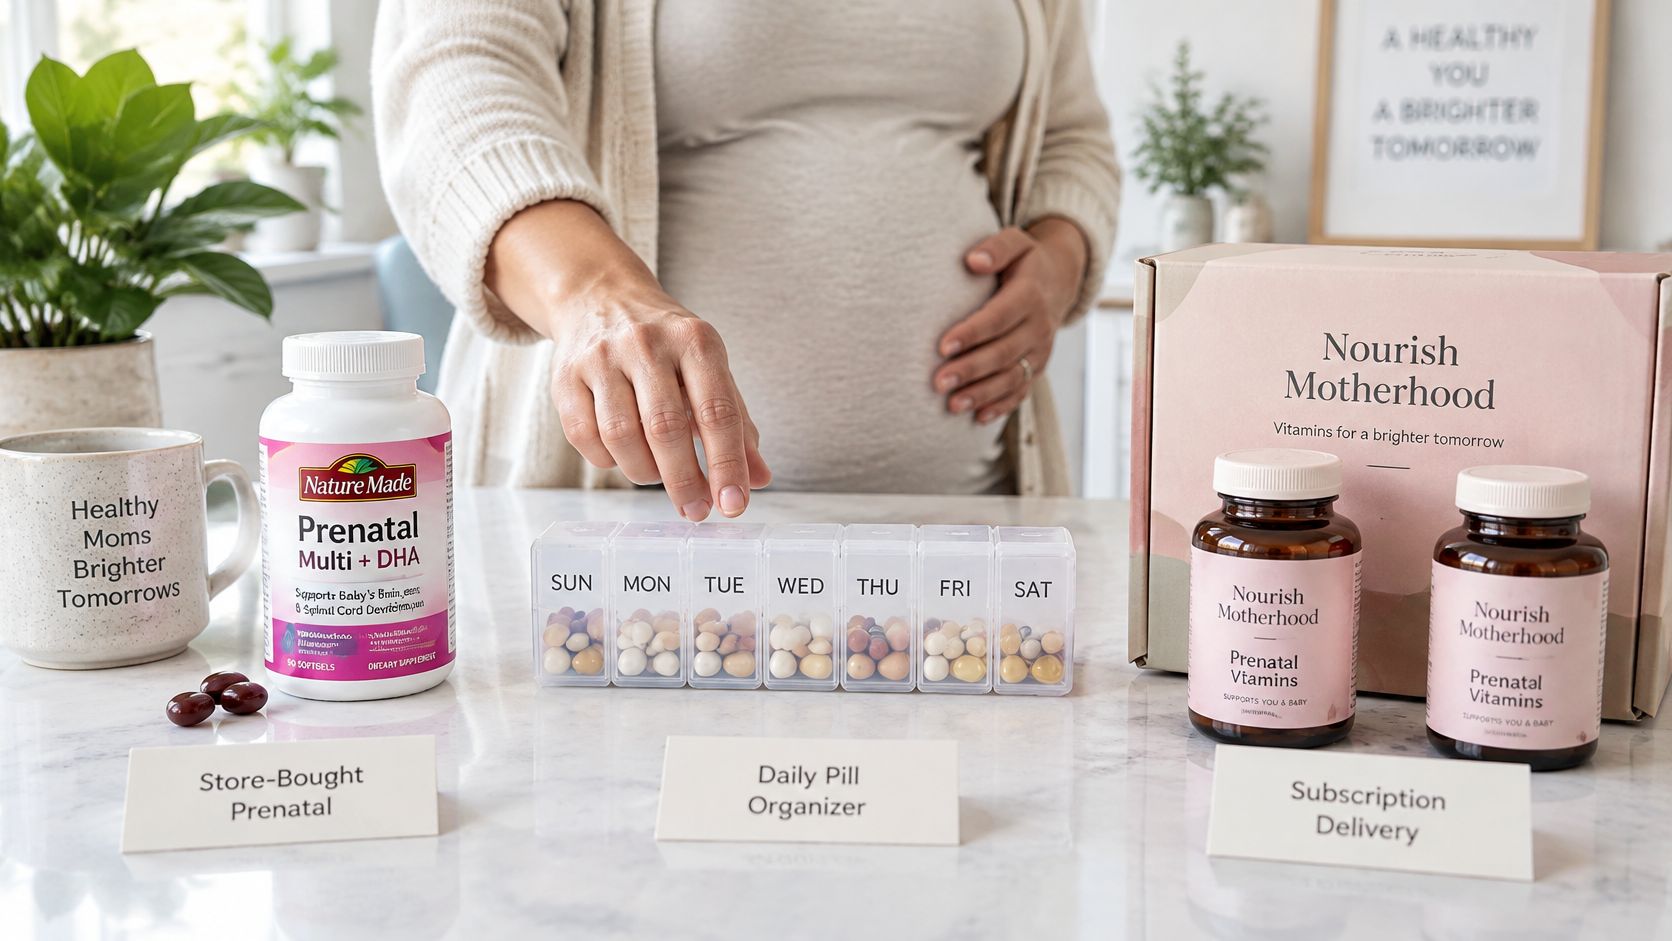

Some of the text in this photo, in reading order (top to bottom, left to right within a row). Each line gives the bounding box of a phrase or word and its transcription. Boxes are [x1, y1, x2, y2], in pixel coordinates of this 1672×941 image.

[1381, 24, 1539, 49] A HEALTHY
[1430, 62, 1489, 88] YOU
[1372, 98, 1540, 124] A BRIGHTER
[1371, 135, 1541, 161] TOMORROW
[1322, 332, 1459, 366] Nourish
[1284, 369, 1496, 410] Motherhood
[1273, 421, 1505, 448] Vitamins for a brighter tomorrow
[304, 472, 413, 495] Nature Made
[71, 495, 159, 520] Healthy
[84, 529, 152, 549] Moms
[298, 510, 419, 544] Prenatal
[73, 556, 166, 582] Brighter
[299, 545, 420, 571] Multi + DHA
[57, 581, 181, 608] Tomorrows
[550, 574, 593, 591] SUN
[623, 575, 671, 592] MON
[704, 576, 745, 594] TUE
[777, 577, 825, 595] WED
[856, 578, 899, 596] THU
[940, 579, 971, 597] FRI
[1014, 581, 1053, 598] SAT
[1232, 585, 1305, 605] Nourish
[337, 605, 364, 616] Cord
[1218, 603, 1320, 626] Motherhood
[1474, 601, 1550, 623] Nourish
[1459, 620, 1564, 645] Motherhood
[1230, 650, 1299, 670] Prenatal
[1470, 669, 1542, 690] Prenatal
[1223, 693, 1259, 705] SUPPORTS
[1469, 688, 1544, 709] Vitamins
[1505, 719, 1523, 727] YOU
[200, 765, 364, 792] Store-Bought
[758, 765, 859, 789] Daily Pill
[1290, 780, 1447, 811] Subscription
[231, 797, 332, 821] Prenatal
[748, 796, 866, 820] Organizer
[1316, 815, 1420, 847] Delivery
